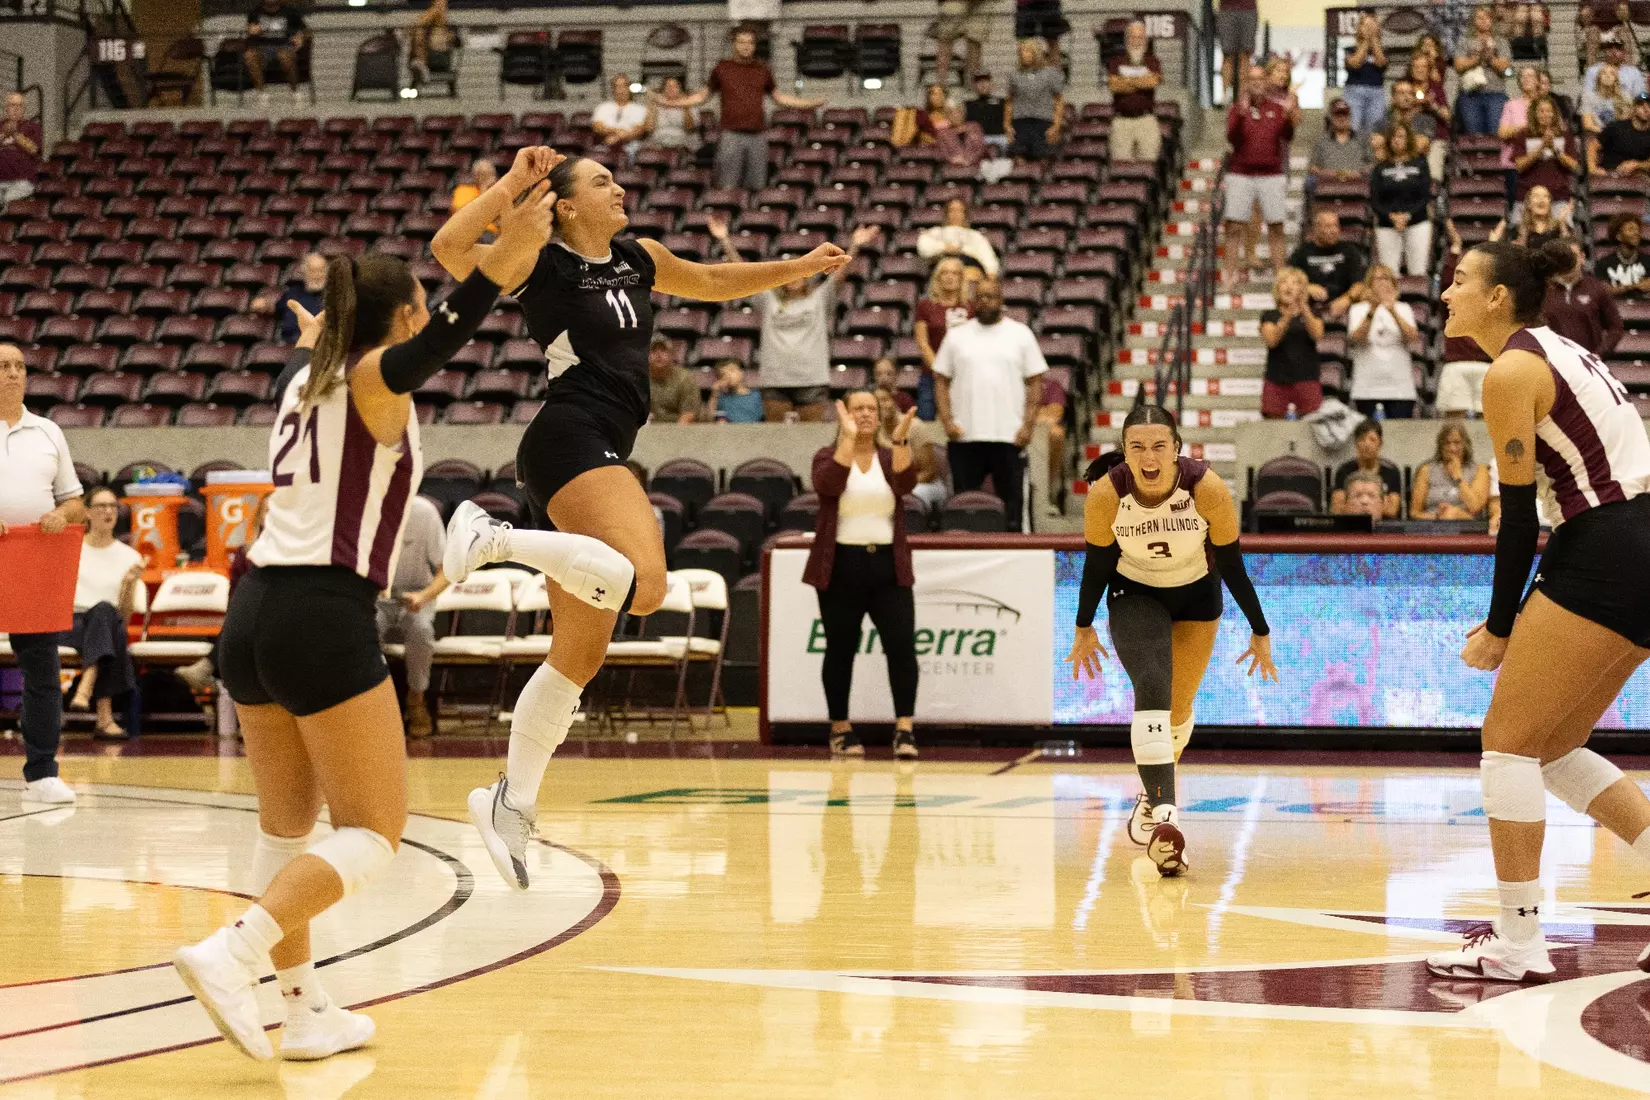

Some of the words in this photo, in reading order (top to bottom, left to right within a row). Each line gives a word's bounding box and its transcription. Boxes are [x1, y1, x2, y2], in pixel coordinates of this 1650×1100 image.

[1144, 14, 1175, 37] 116
[98, 38, 127, 62] 116
[605, 288, 638, 329] 11
[271, 405, 321, 488] 21
[136, 507, 157, 530] G
[220, 498, 244, 524] G
[1115, 518, 1160, 538] SOUTHERN
[1161, 517, 1200, 533] ILLINOIS
[1147, 541, 1173, 559] 3
[918, 661, 996, 676] CENTER
